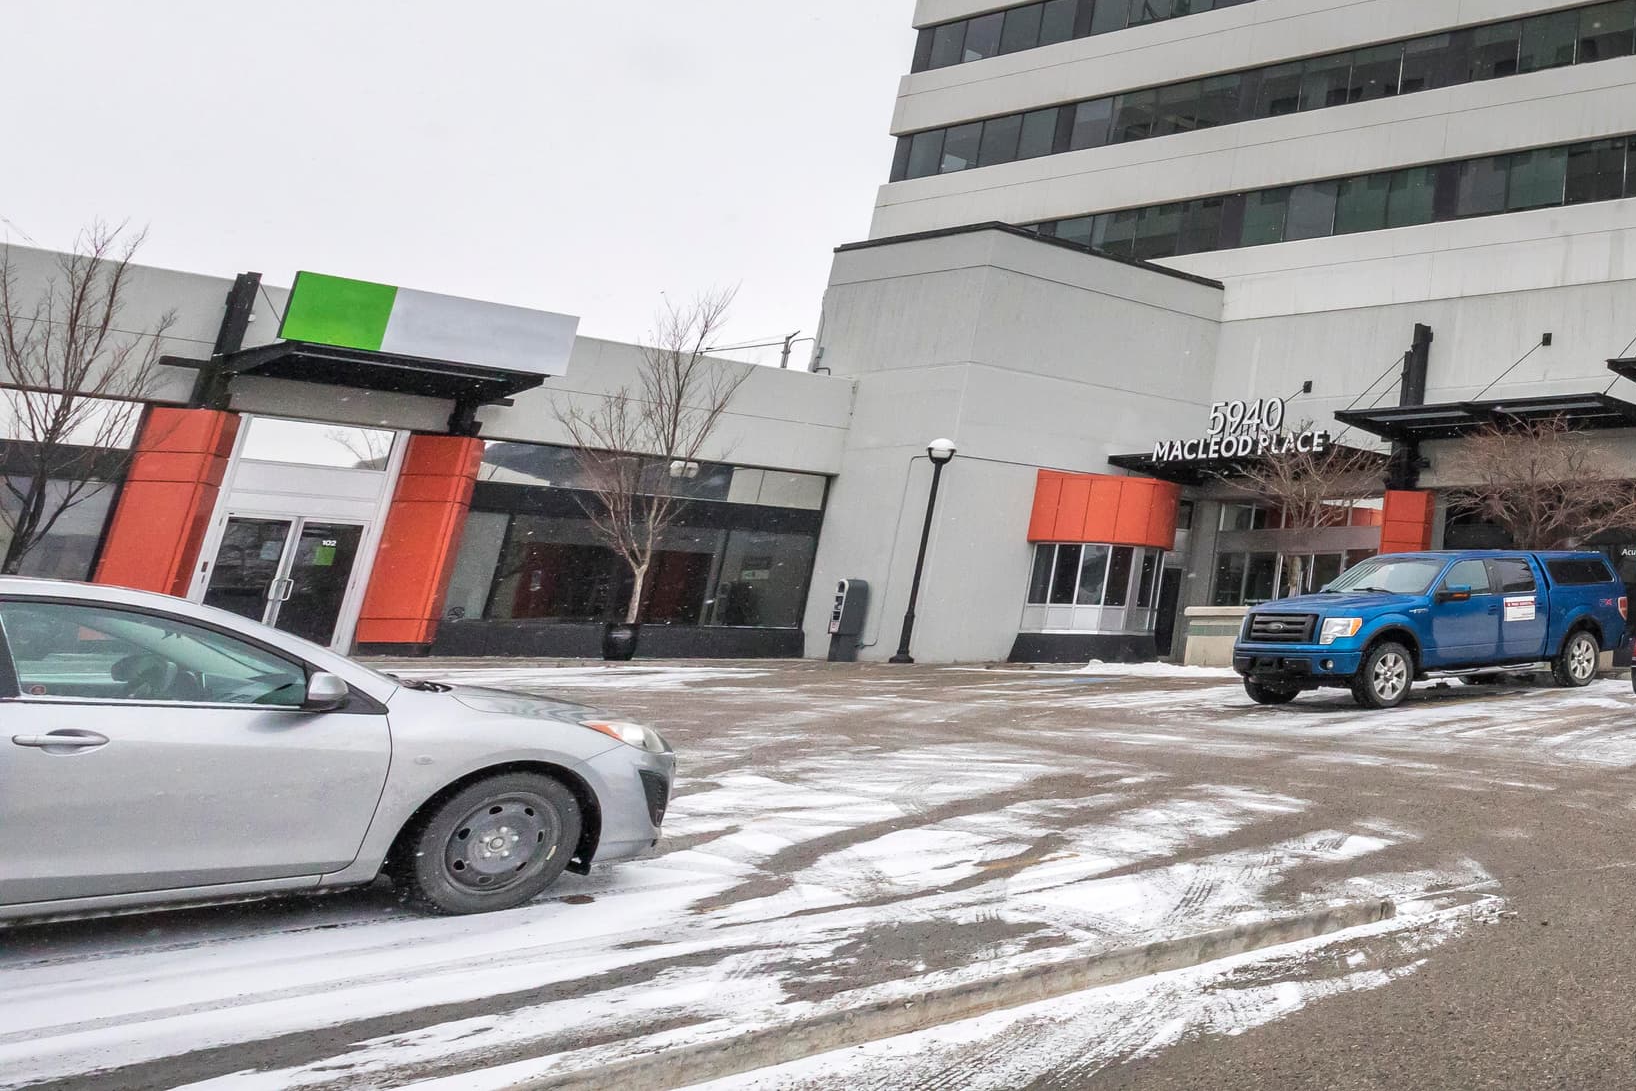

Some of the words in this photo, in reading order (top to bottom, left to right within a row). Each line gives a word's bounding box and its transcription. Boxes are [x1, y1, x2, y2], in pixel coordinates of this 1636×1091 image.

[1206, 397, 1284, 434] 5940
[1152, 435, 1253, 461] MACLEOD
[1257, 430, 1327, 455] PLACE
